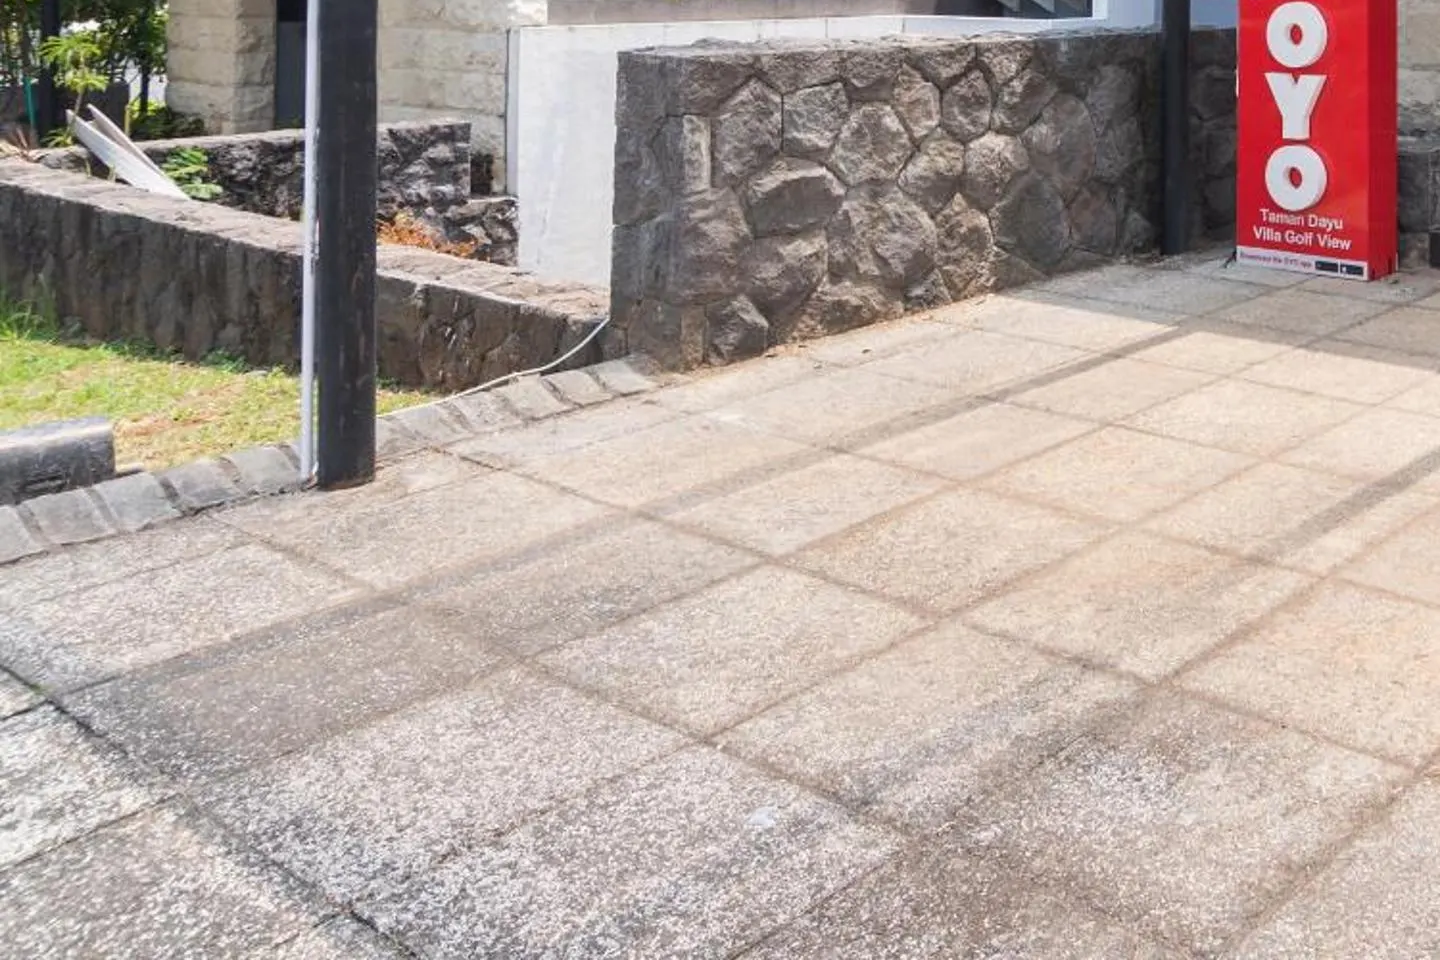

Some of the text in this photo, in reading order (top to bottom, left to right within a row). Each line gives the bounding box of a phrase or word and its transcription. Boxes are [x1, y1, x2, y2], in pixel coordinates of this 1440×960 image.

[1264, 1, 1328, 211] OYO
[1259, 208, 1344, 232] Taman Dayu
[1253, 225, 1352, 250] Villa Golf View
